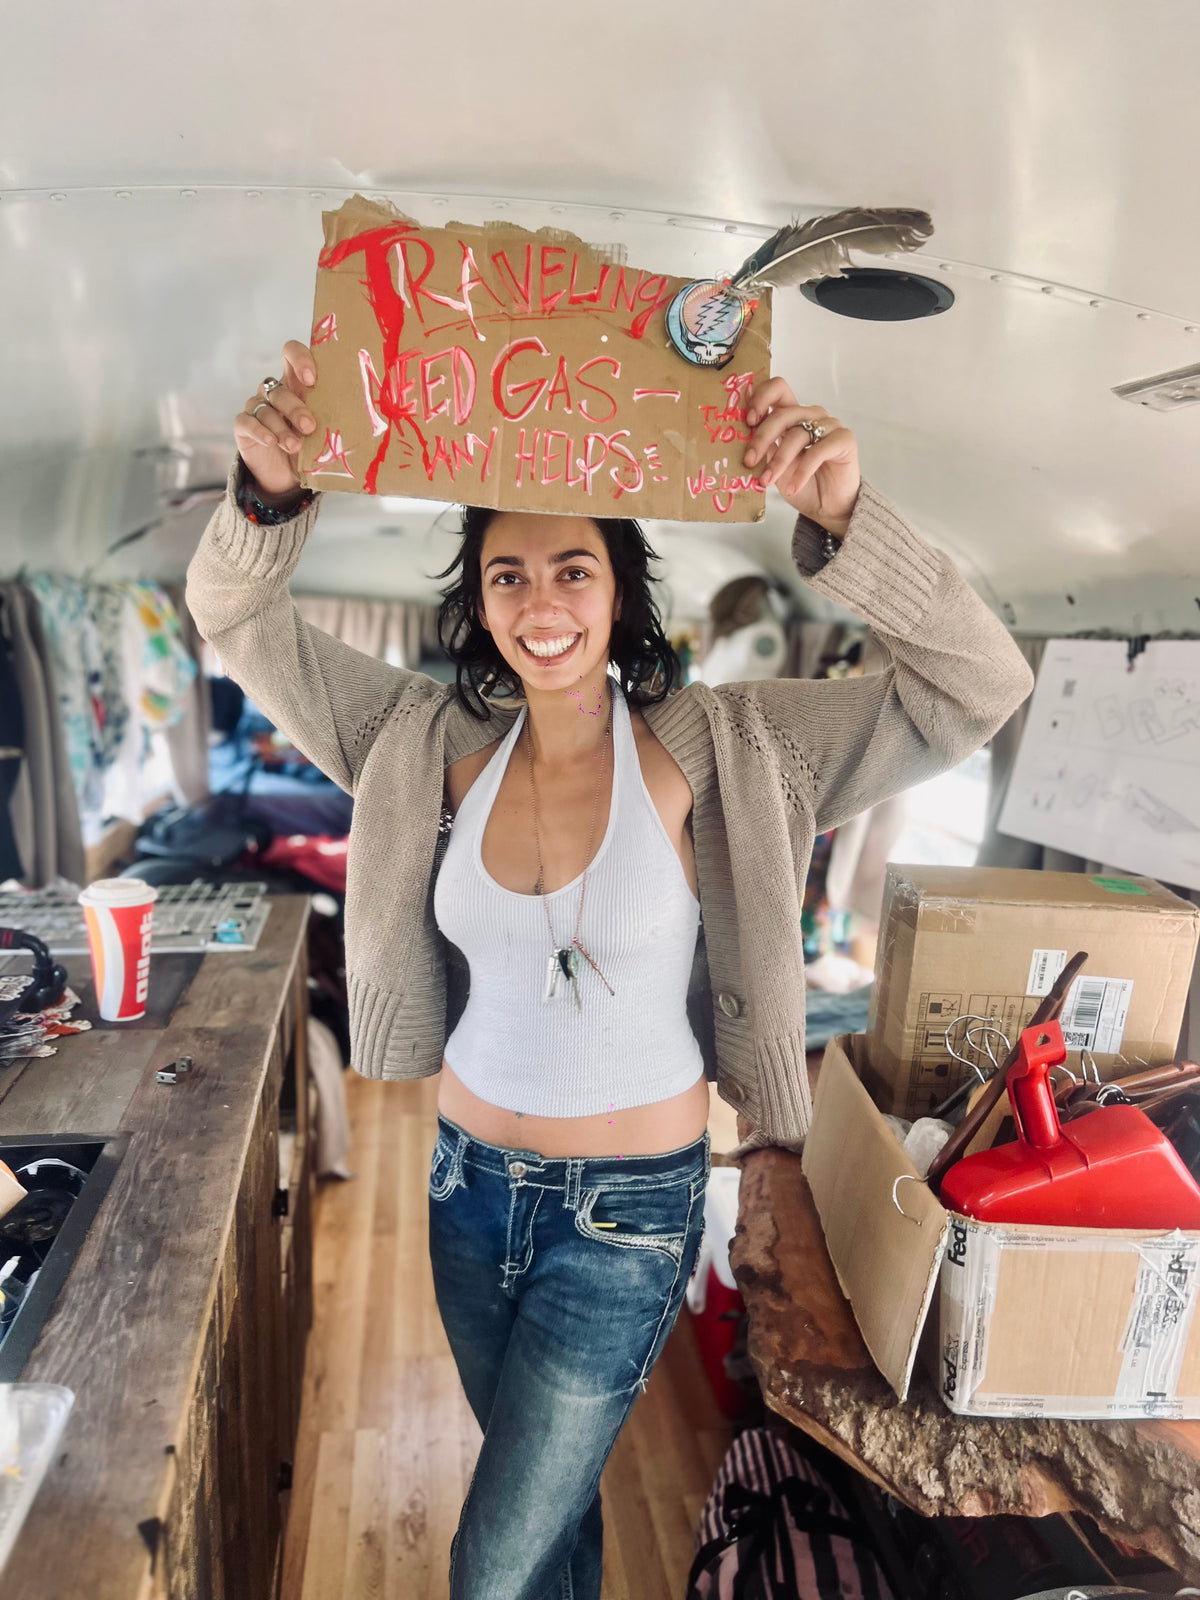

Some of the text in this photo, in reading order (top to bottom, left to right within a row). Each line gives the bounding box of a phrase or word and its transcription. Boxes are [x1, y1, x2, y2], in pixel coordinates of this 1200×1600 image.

[358, 346, 477, 437] NEED
[490, 336, 621, 423] GAS
[699, 405, 748, 423] THAN
[704, 422, 754, 443] YOU
[429, 427, 644, 496] ANY HELPS
